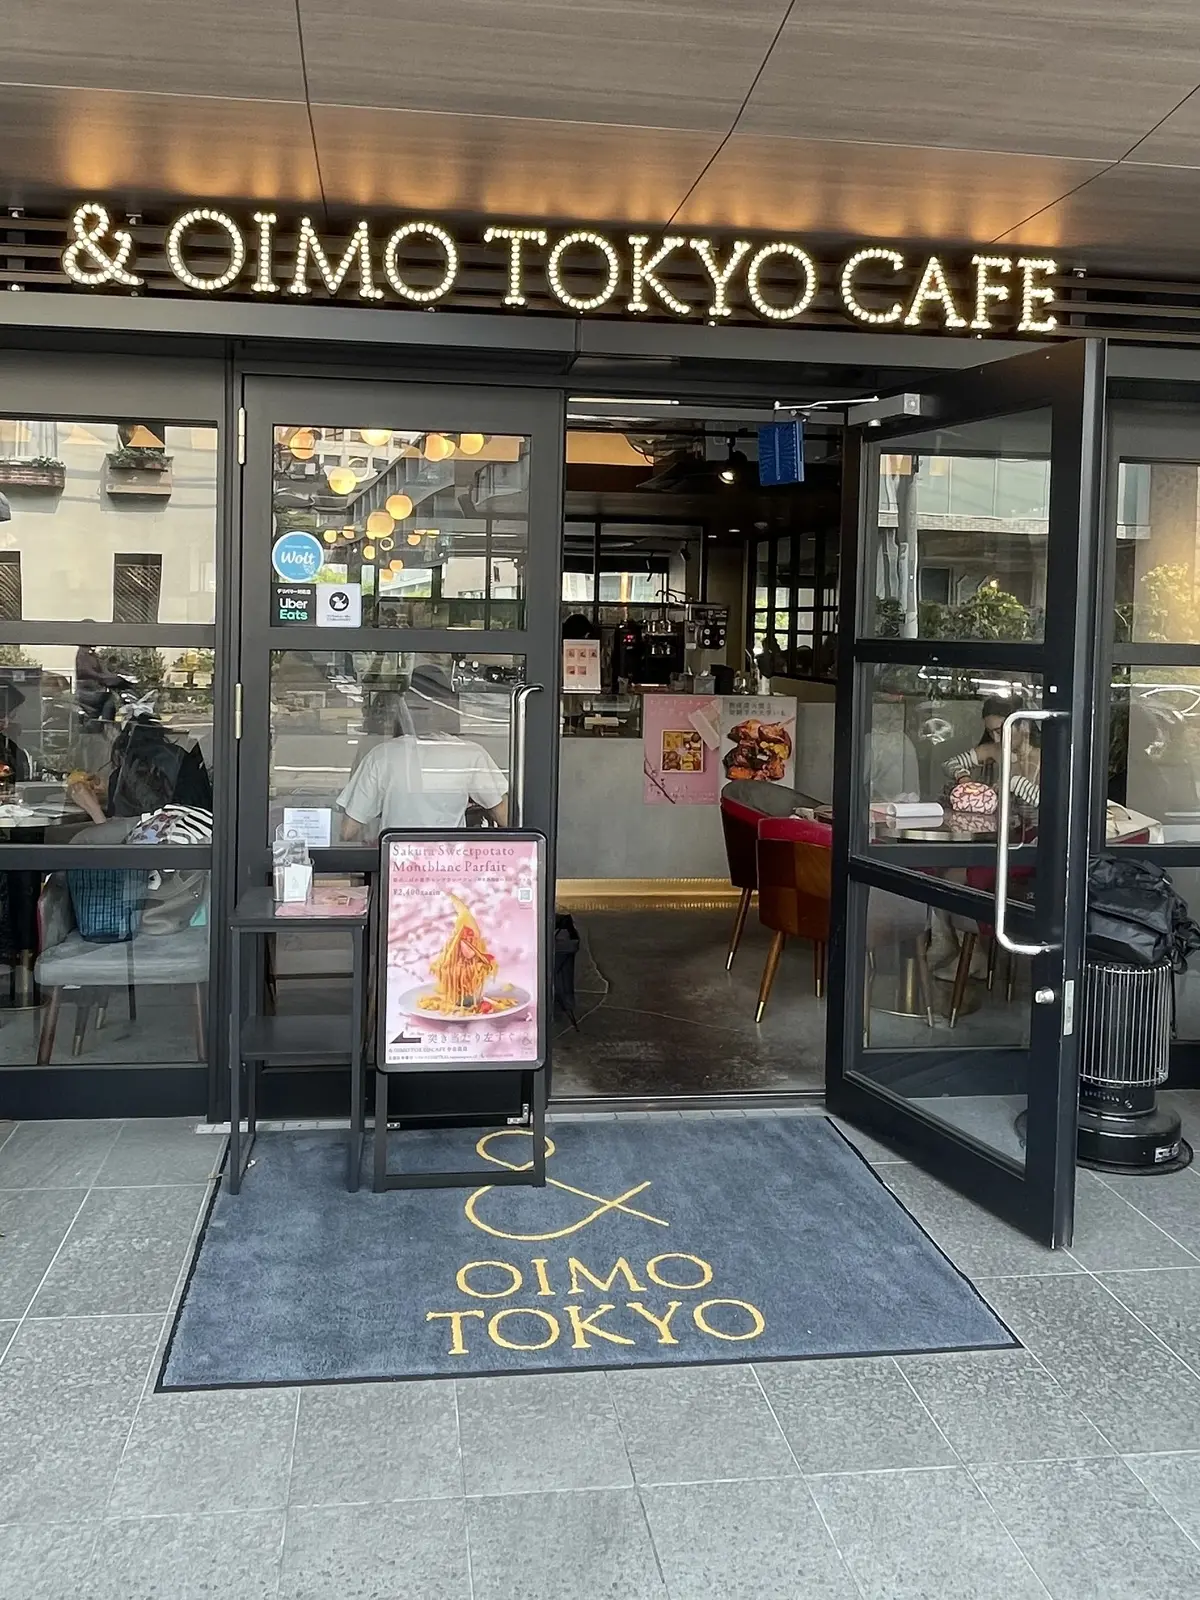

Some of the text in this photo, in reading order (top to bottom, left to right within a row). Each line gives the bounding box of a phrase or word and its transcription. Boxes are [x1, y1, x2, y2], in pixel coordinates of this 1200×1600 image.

[61, 203, 1057, 332] & OIMO TOKYO CAFE
[281, 551, 316, 565] Wolt
[279, 597, 309, 609] Uber
[279, 609, 308, 620] Eats
[392, 844, 514, 859] Sakura Sweetpotato
[392, 860, 507, 873] Montblanc Parfait
[456, 1252, 713, 1299] OIMO
[425, 1298, 766, 1356] TOKYO
